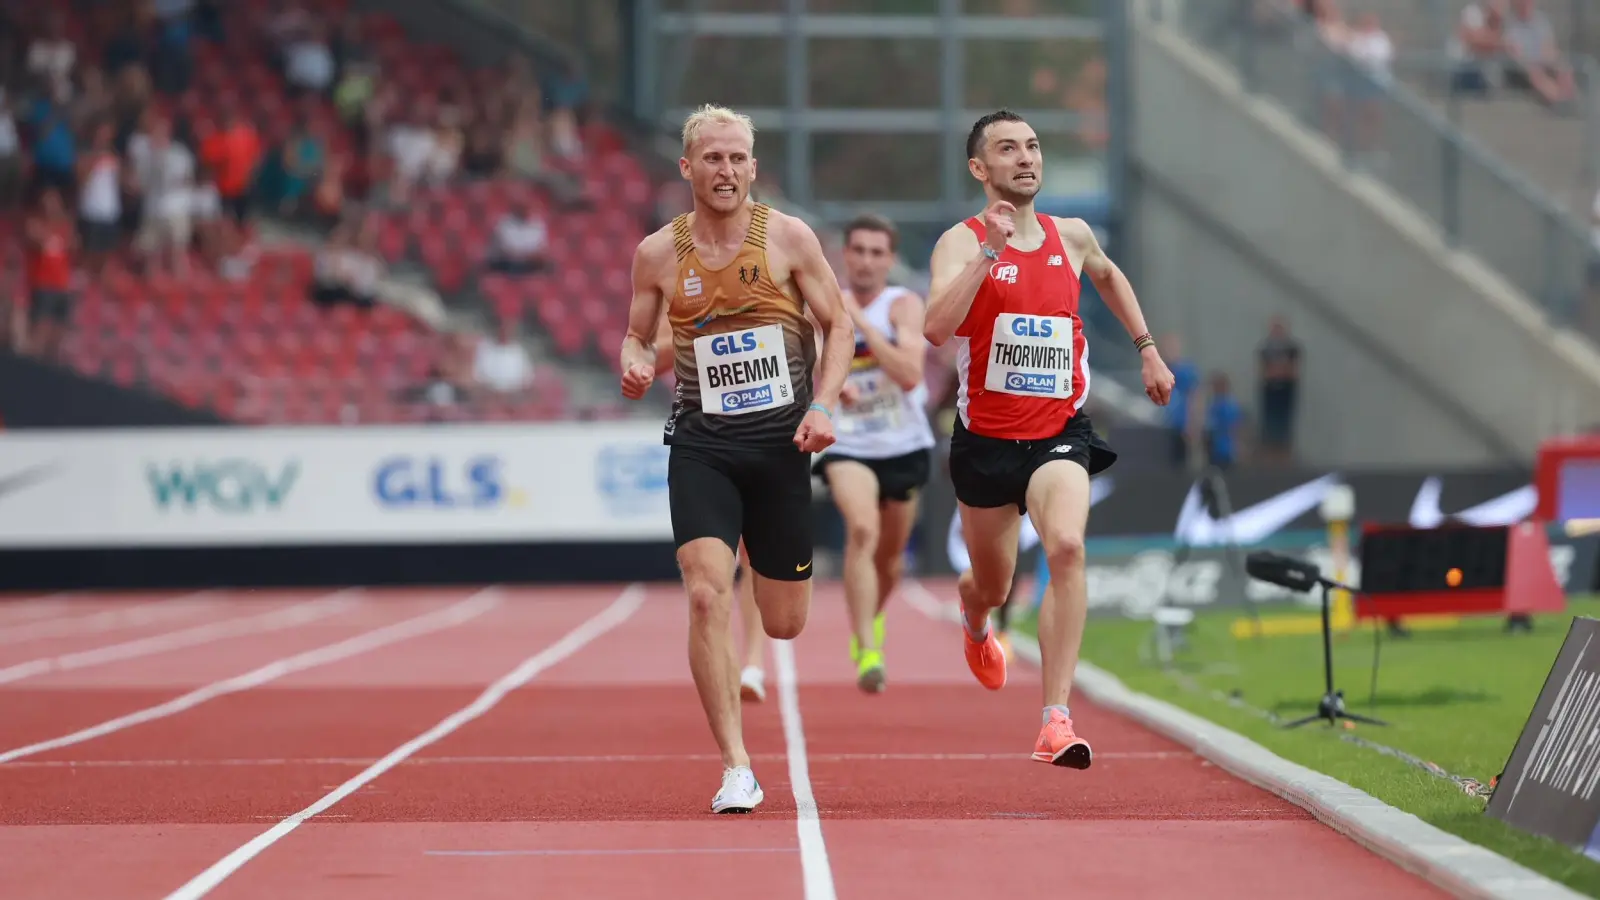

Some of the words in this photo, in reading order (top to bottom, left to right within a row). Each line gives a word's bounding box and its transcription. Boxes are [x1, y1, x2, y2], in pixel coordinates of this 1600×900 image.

[995, 342, 1070, 370] THORWIRTH
[706, 355, 780, 388] BREMM
[1026, 377, 1054, 387] PLAN
[741, 388, 770, 402] PLAN
[779, 383, 788, 398] 230
[146, 460, 299, 513] WGV
